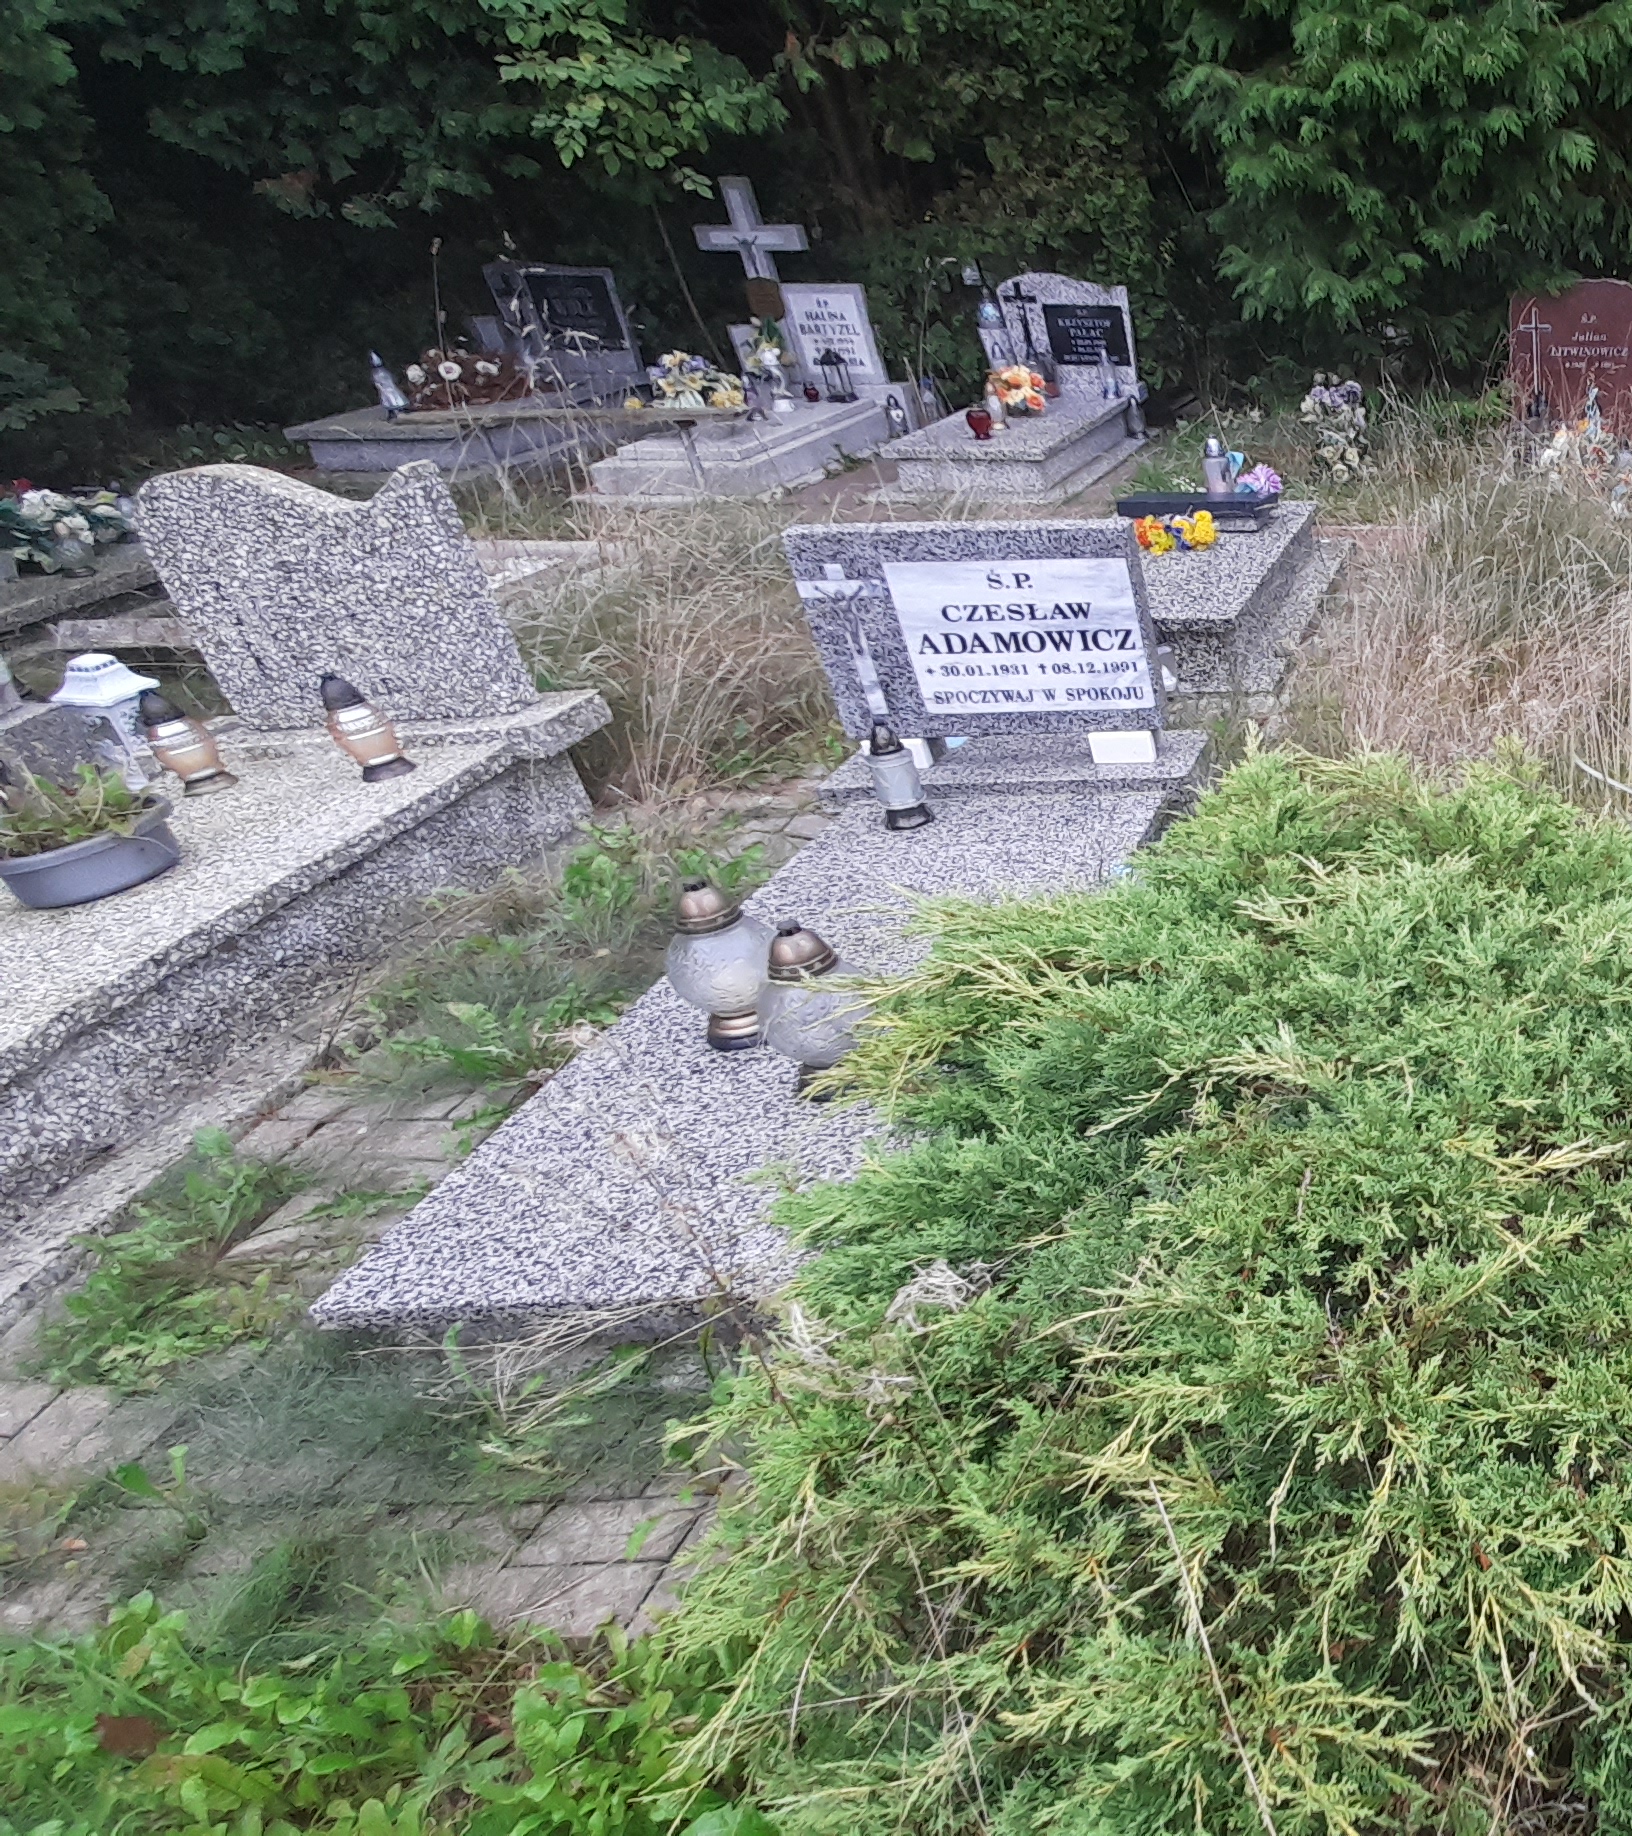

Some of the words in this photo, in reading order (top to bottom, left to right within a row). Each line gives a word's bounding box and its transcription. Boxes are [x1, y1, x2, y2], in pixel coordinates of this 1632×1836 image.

[986, 569, 1033, 590] Ś.P.
[941, 602, 1092, 623] CZESŁAW
[918, 629, 1137, 655] ADAMOWICZ
[933, 689, 1035, 705] SPOCZYWAJ
[1041, 688, 1056, 702] W
[1066, 686, 1145, 702] SPOKOJU
